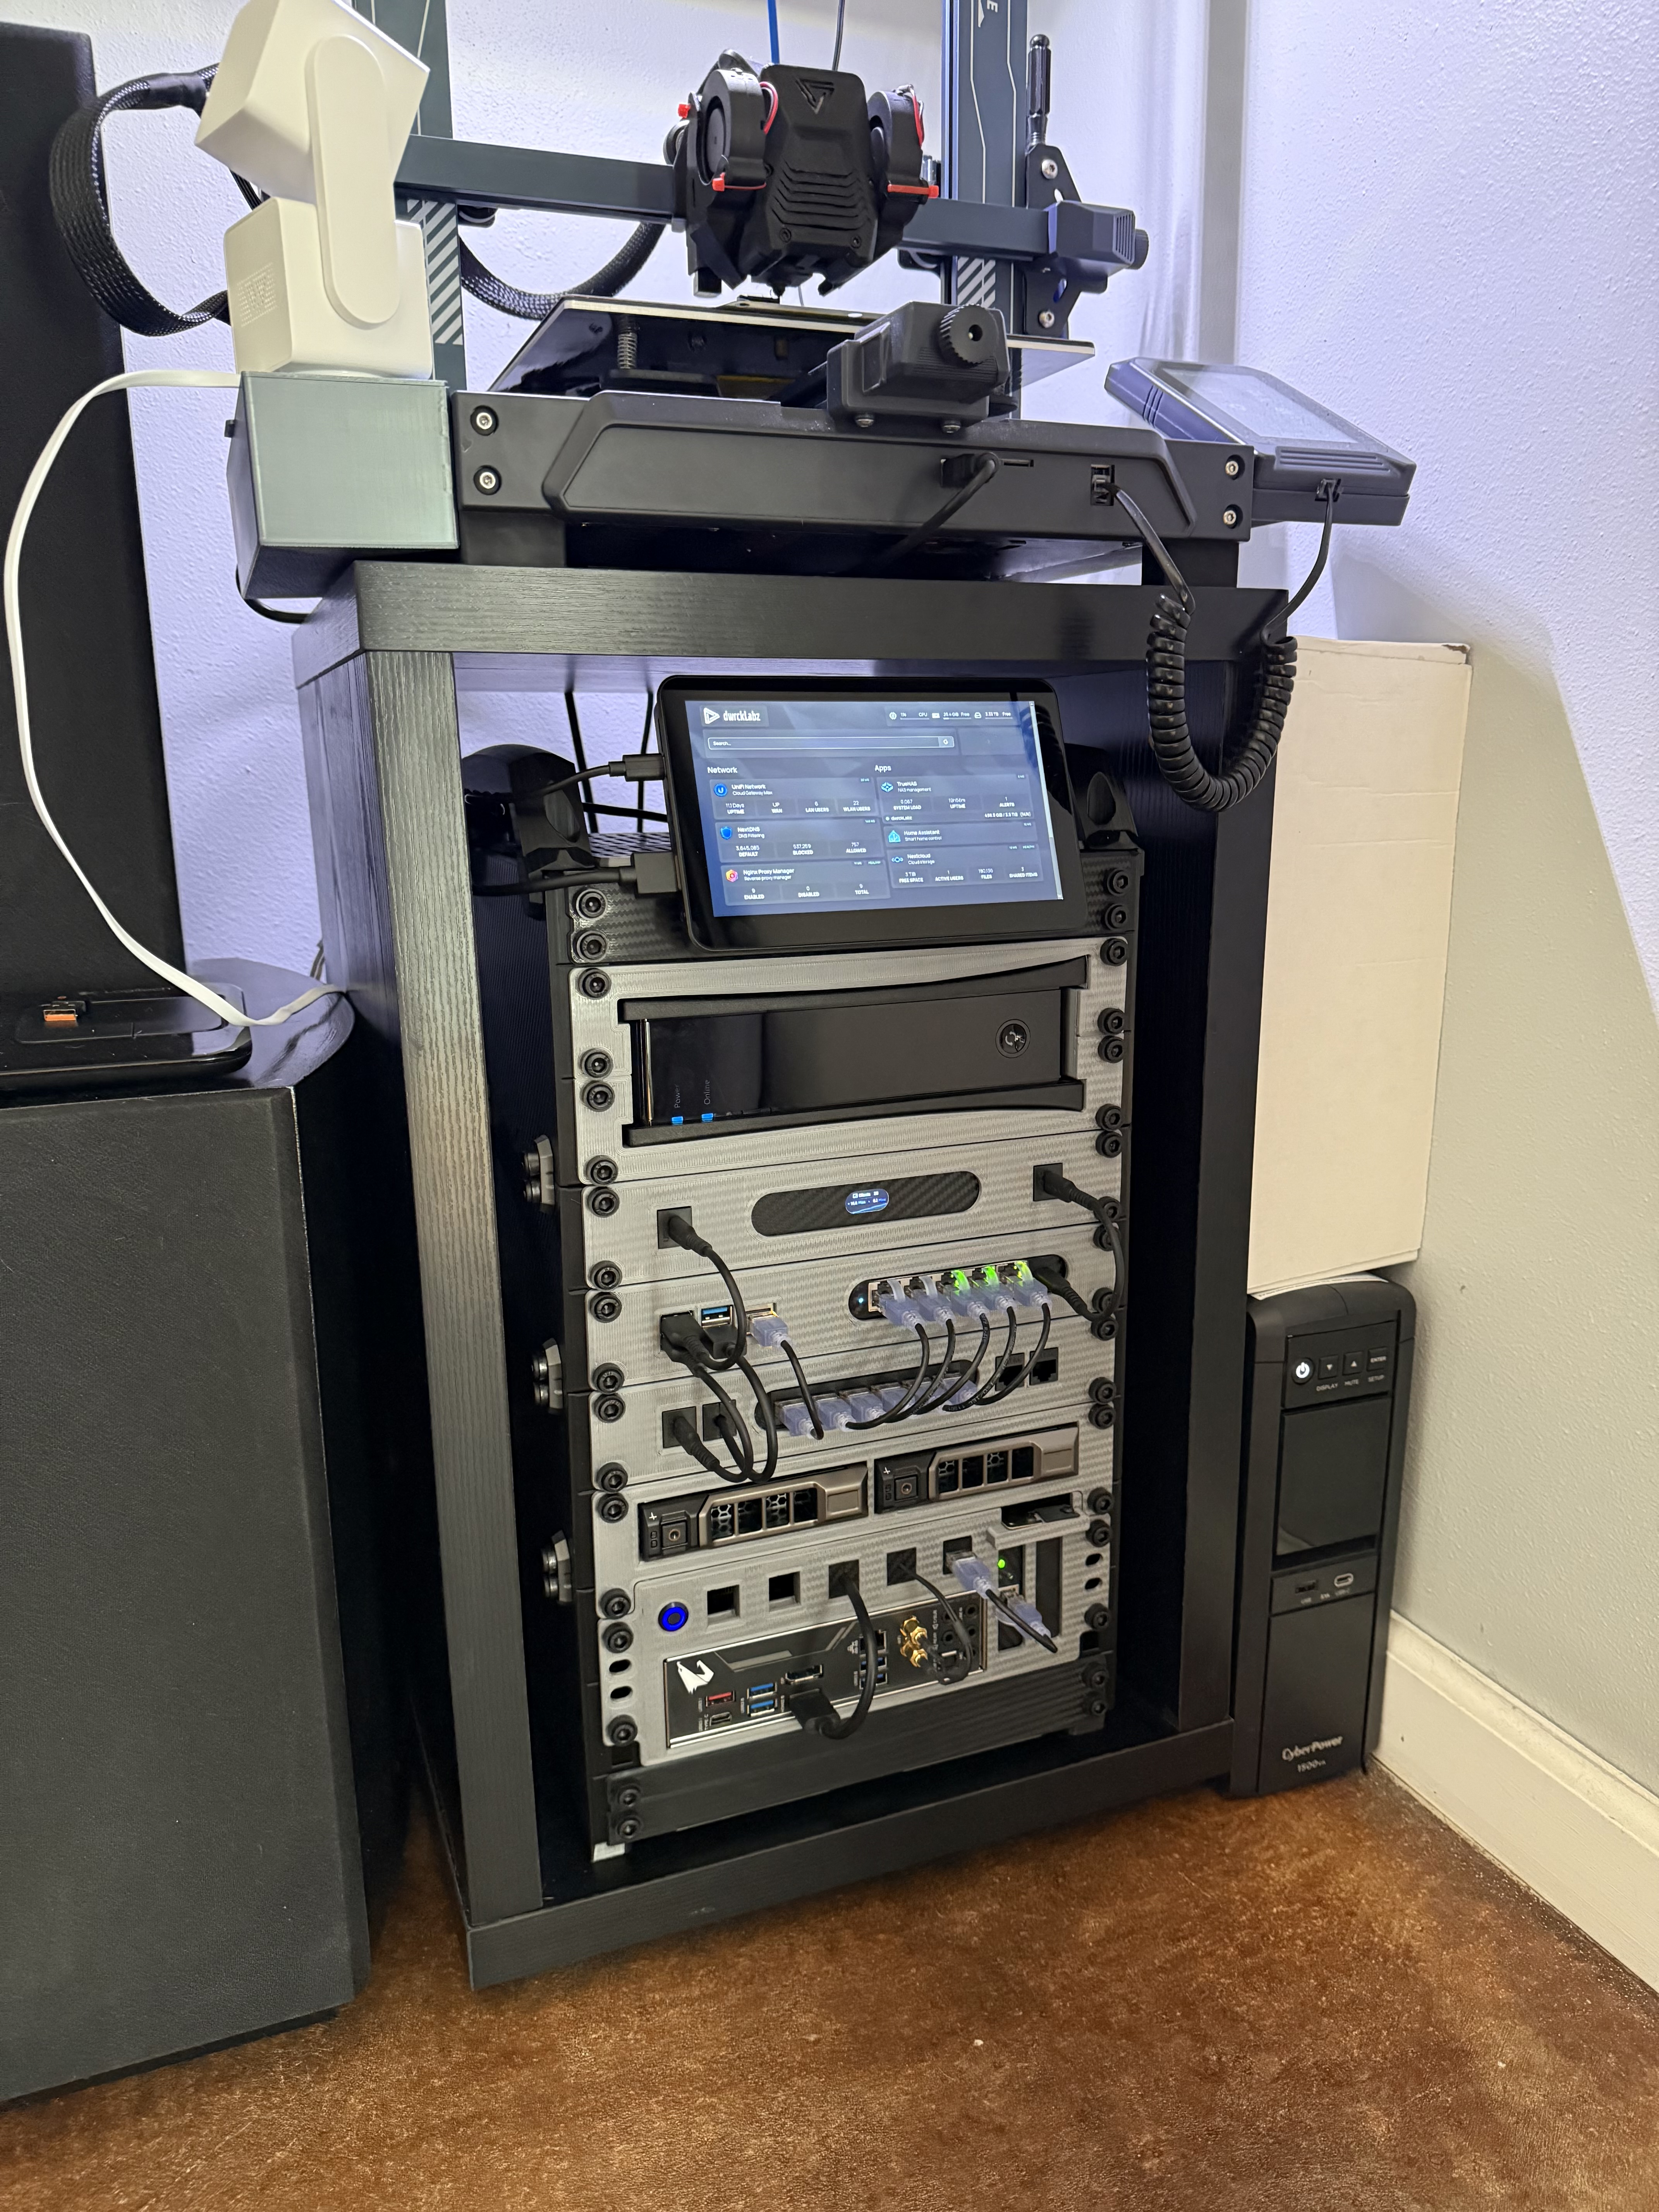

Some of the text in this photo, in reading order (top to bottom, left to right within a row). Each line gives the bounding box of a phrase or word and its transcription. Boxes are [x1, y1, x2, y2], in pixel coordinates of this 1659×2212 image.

[723, 710, 761, 721] dwrckLabz
[1316, 1382, 1338, 1391] DISPLAY
[1282, 1736, 1343, 1762] CyberPower
